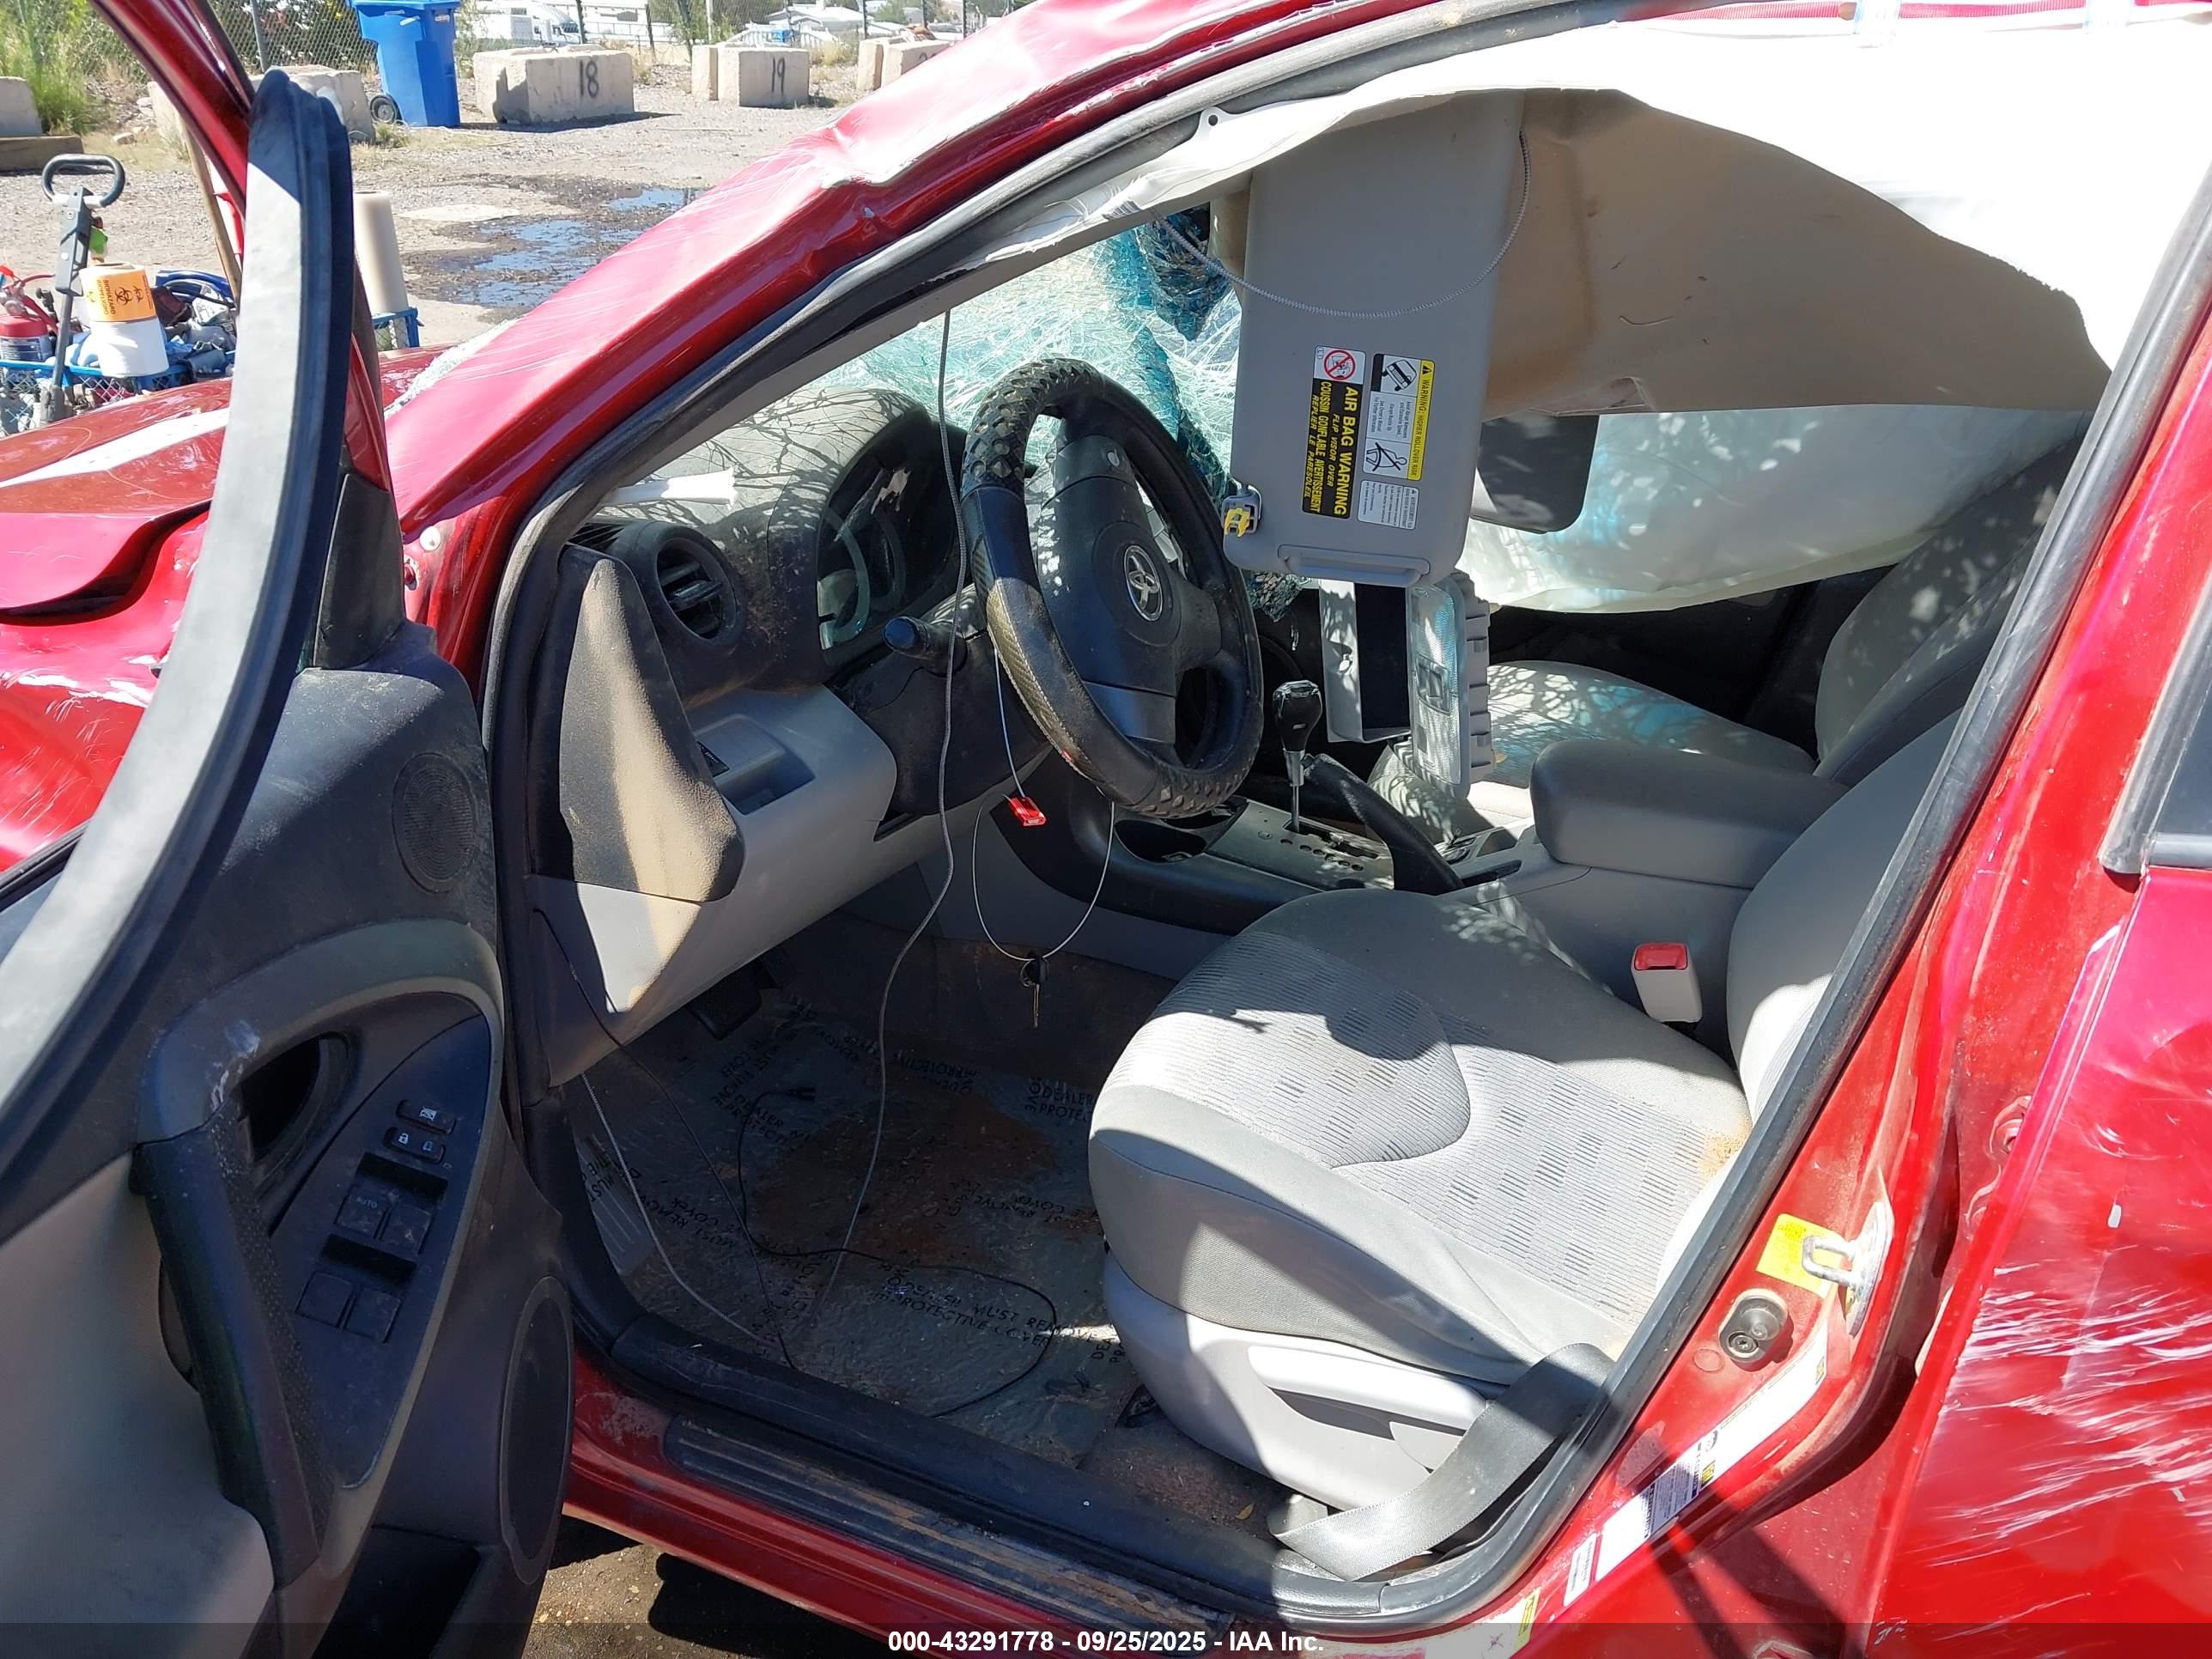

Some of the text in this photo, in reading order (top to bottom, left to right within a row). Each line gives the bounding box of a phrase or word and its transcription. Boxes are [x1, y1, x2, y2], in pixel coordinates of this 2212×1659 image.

[579, 60, 599, 98] 18
[770, 57, 786, 94] 19
[1419, 380, 1430, 414] WARNING:
[1310, 395, 1320, 429] REPLIER
[1415, 416, 1425, 435] HIGHER
[1309, 434, 1316, 447] LE
[1310, 381, 1332, 513] COUSSIN GONFLABLE AVERTISSEMENT
[1329, 436, 1338, 461] VISOR
[1334, 386, 1358, 515] AIR BAG WARNING
[1411, 436, 1422, 464] ROLLOVER
[1327, 465, 1336, 487] OVER
[1043, 1085, 1093, 1106] DEALER
[356, 1195, 378, 1210] AUTO
[974, 1303, 1019, 1322] MUST
